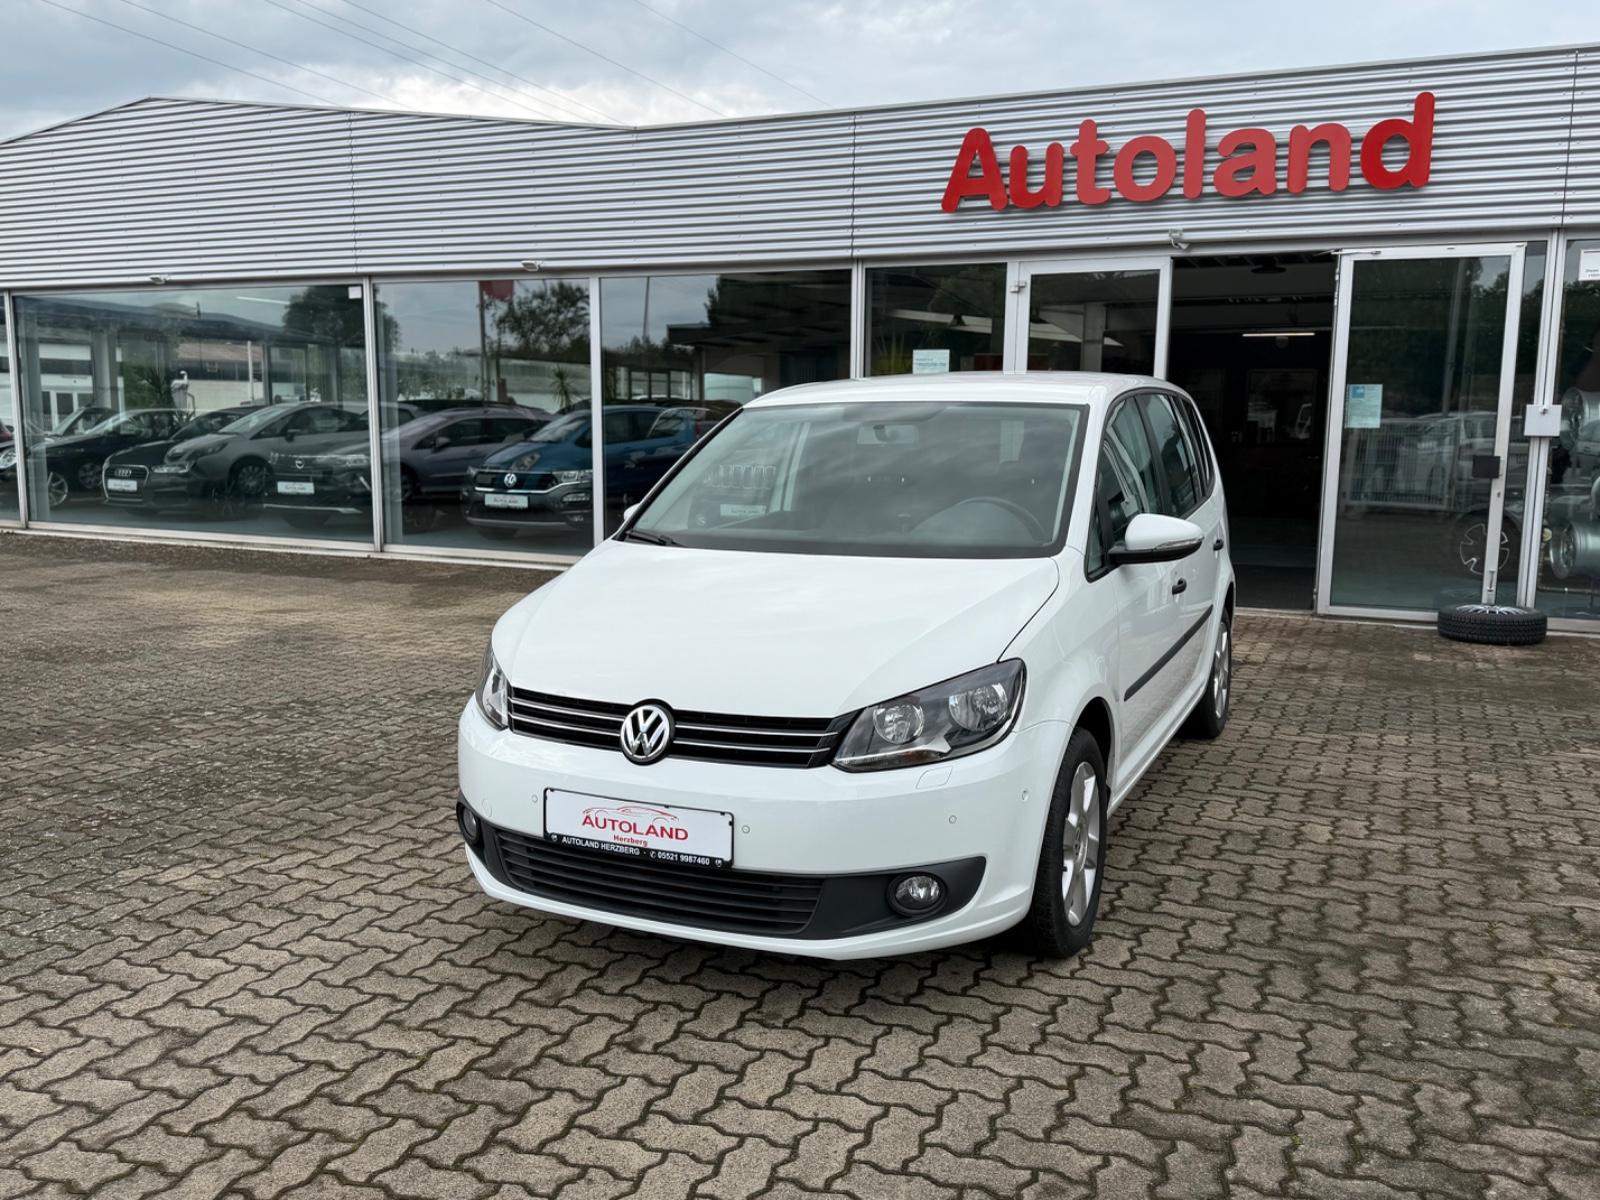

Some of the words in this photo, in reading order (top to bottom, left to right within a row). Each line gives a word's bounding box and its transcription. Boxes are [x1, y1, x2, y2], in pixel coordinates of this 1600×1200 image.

[941, 91, 1436, 214] Autoland
[582, 814, 689, 841] AUTOLAND
[561, 836, 600, 849] AUTOLAND
[601, 843, 640, 856] HERZBERG
[613, 834, 648, 848] Herzberg
